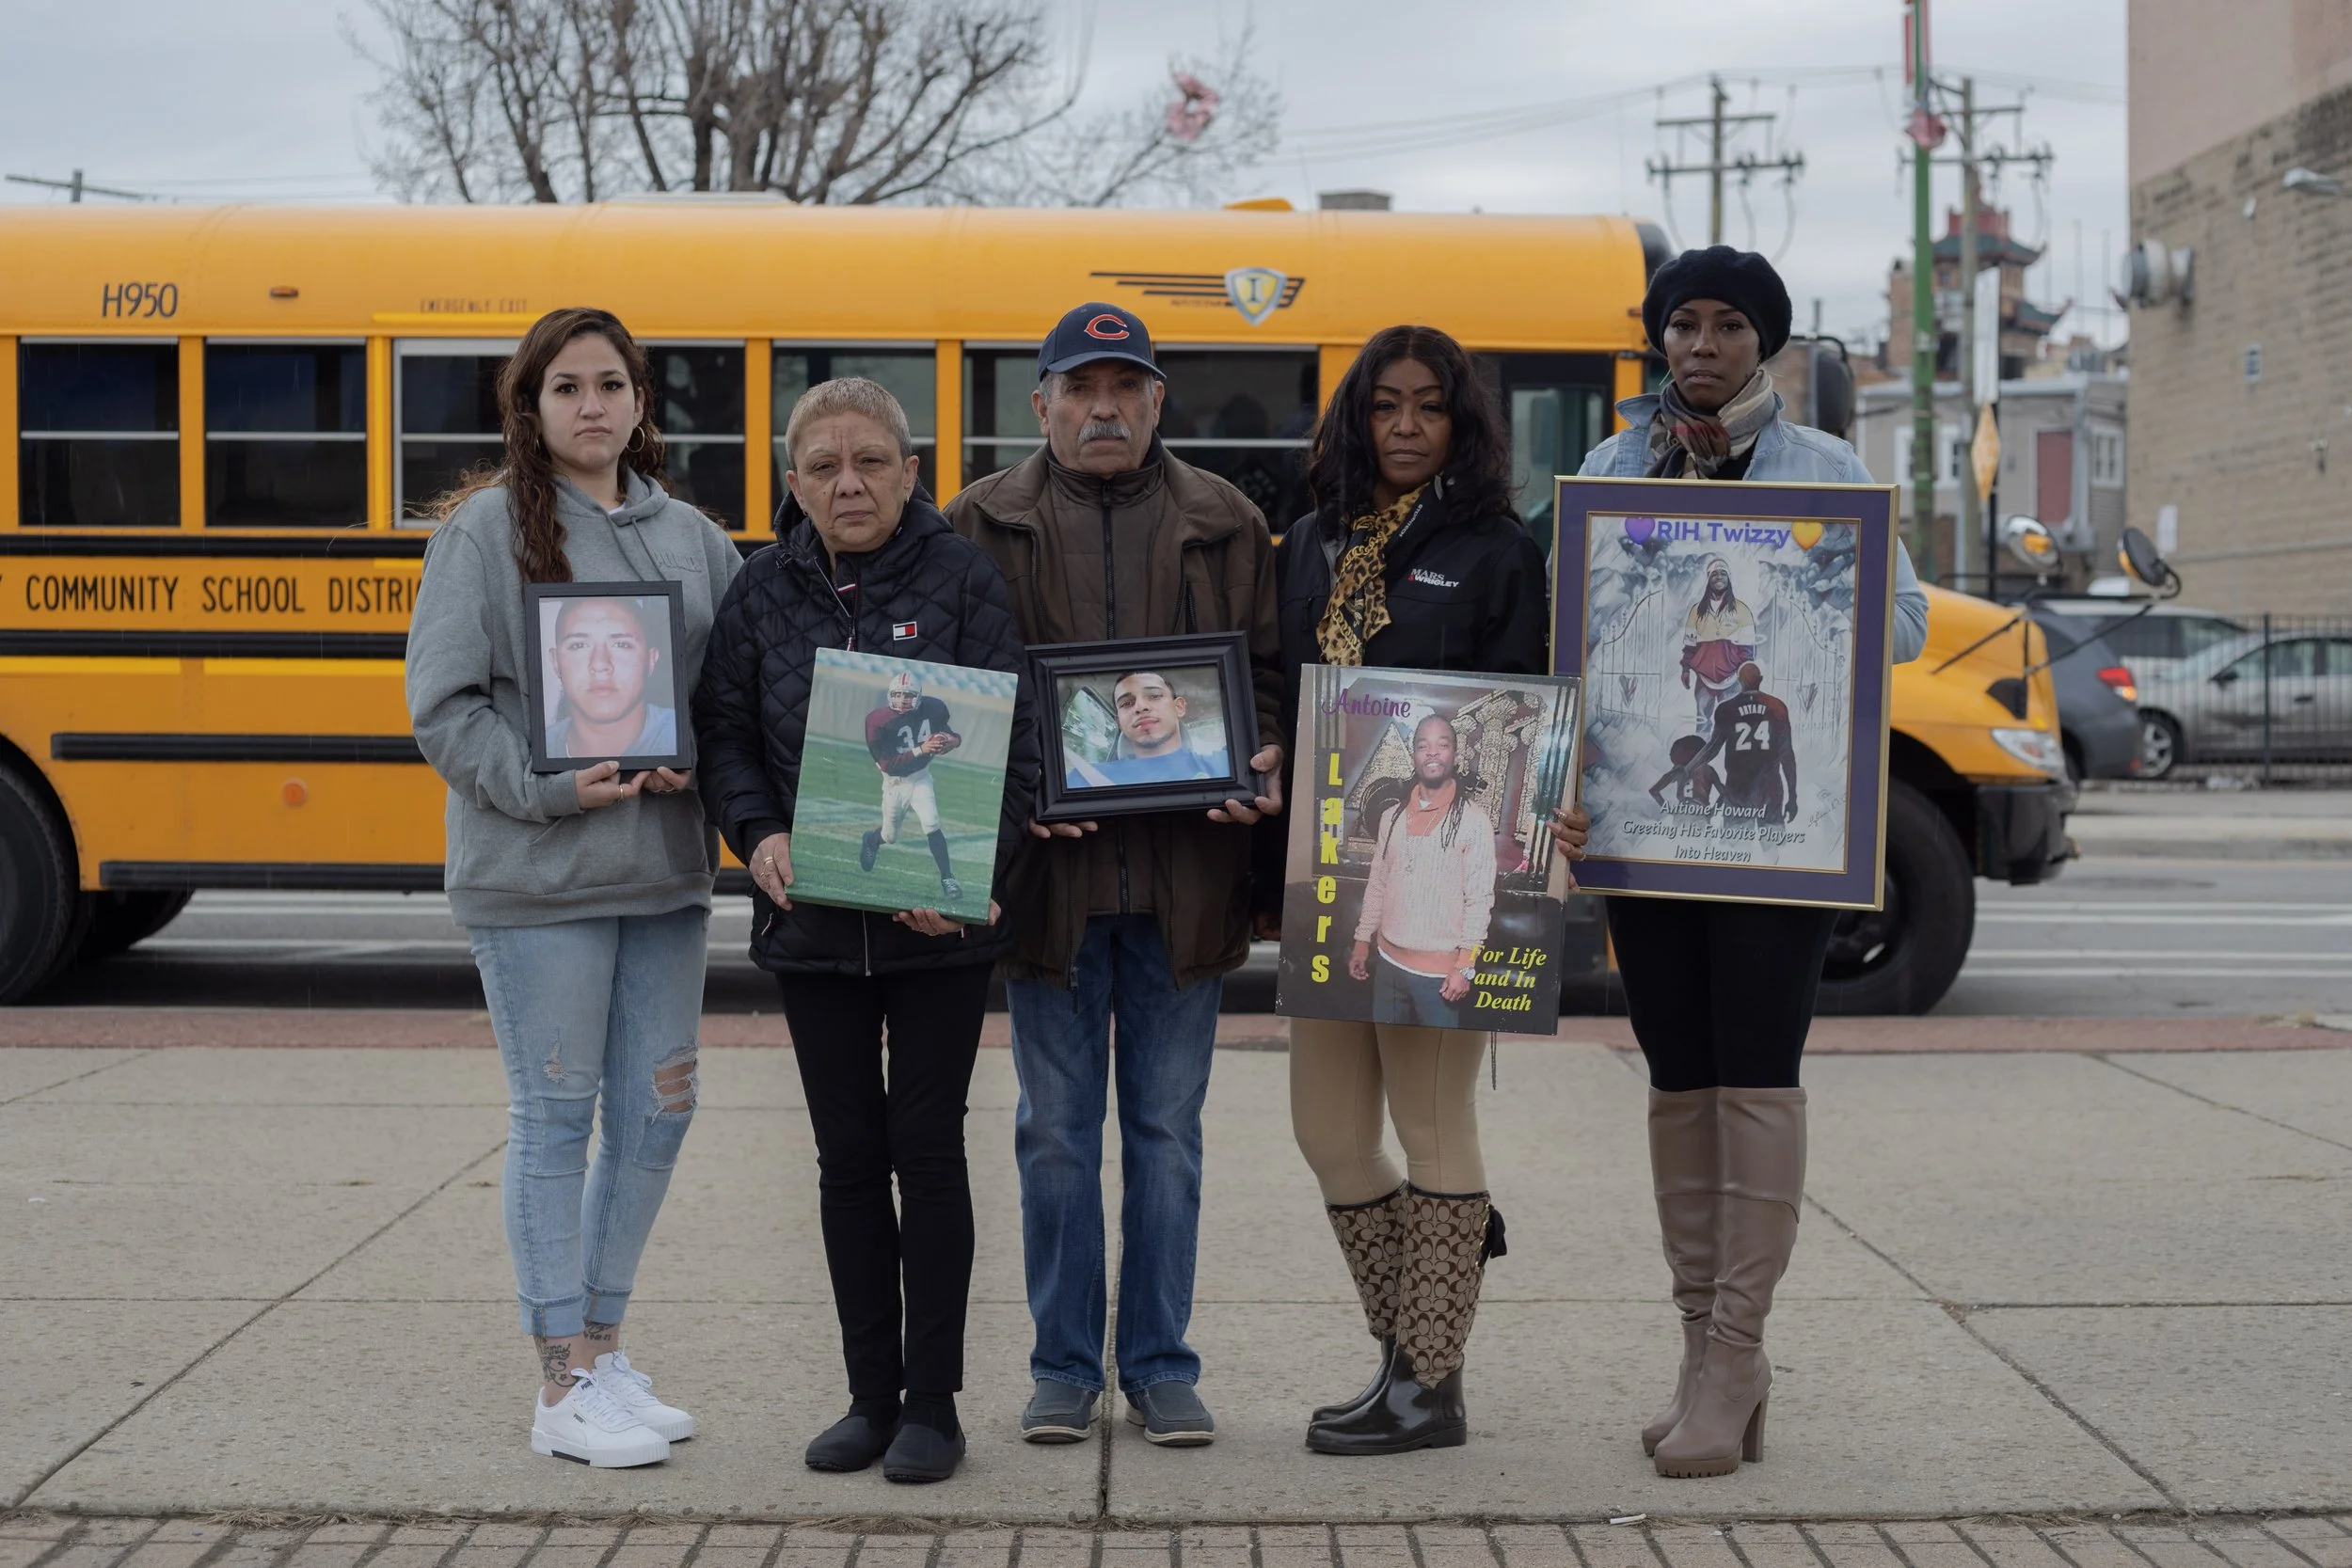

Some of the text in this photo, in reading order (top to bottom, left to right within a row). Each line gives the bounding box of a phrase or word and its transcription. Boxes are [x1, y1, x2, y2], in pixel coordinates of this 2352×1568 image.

[102, 282, 178, 318] H950
[1084, 313, 1130, 341] C
[1658, 520, 1791, 549] RIH Twizzy
[1410, 568, 1445, 580] MARS
[1414, 575, 1459, 588] WRIGLEY
[25, 575, 179, 612] COMMUNITY
[202, 576, 306, 613] SCHOOL
[1321, 688, 1412, 719] Antoine
[1738, 704, 1767, 717] BRYANT
[897, 719, 931, 754] 34
[1735, 721, 1771, 751] 24
[1660, 800, 1767, 819] Antione Howard
[1622, 820, 1806, 847] Greeting His Favorite Players
[1311, 752, 1343, 983] Lakers
[1674, 845, 1752, 863] Into Heaven
[1469, 943, 1548, 970] For Life
[1473, 970, 1536, 989] and In
[1474, 990, 1532, 1011] Death
